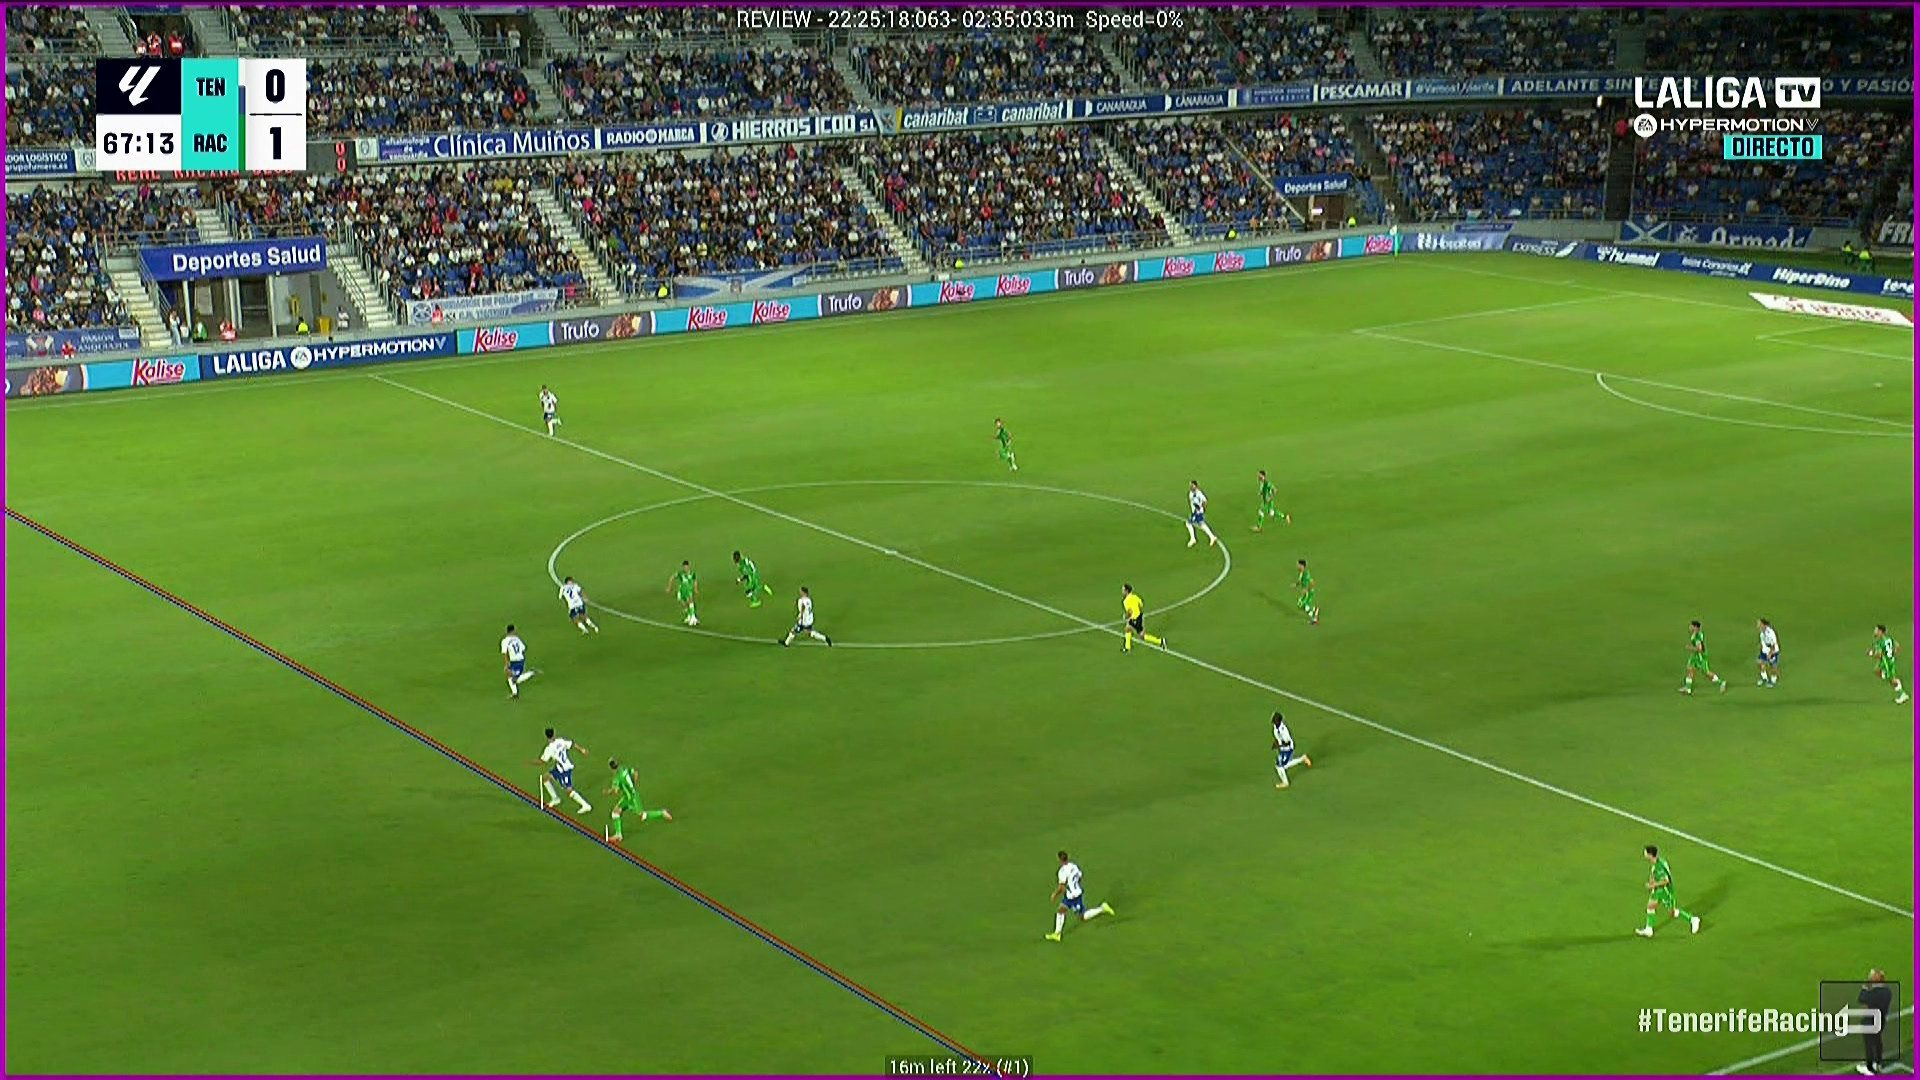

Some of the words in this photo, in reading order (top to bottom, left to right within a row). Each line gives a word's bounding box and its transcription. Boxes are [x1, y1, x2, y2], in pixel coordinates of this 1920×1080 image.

[1320, 82, 1402, 100] PESCAMAR
[1511, 78, 1599, 94] ADELANTE
[1604, 78, 1633, 92] SIN
[1857, 74, 1914, 92] PASIÓ
[1095, 100, 1148, 114] CANARAGUA
[1175, 93, 1224, 108] CANARAGUA
[903, 107, 969, 128] canaribat
[1001, 102, 1065, 123] canaribat
[606, 130, 645, 146] RADIO
[658, 127, 695, 143] MARCA
[731, 116, 812, 142] HIERROS
[815, 113, 856, 136] ICOD
[335, 142, 345, 157] 0
[433, 133, 507, 158] Clínica
[512, 130, 591, 154] Muiños
[337, 158, 347, 173] 0
[1284, 180, 1322, 194] Deportes
[1323, 178, 1348, 191] Salud
[172, 249, 263, 276] Deportes
[267, 244, 322, 267] Salud
[1275, 245, 1302, 263] Trufo
[1608, 245, 1659, 268] hummel
[995, 273, 1032, 297] Kalise
[1063, 269, 1095, 287] Trufo
[1772, 266, 1851, 289] HiperDino
[938, 279, 975, 303] Kalise
[751, 300, 791, 325] Kalise
[827, 295, 863, 312] Trufo
[688, 306, 729, 332] Kalise
[473, 327, 519, 353] Kalise
[559, 321, 600, 340] Trufo
[213, 348, 287, 375] LALIGA
[132, 358, 186, 387] Kalise
